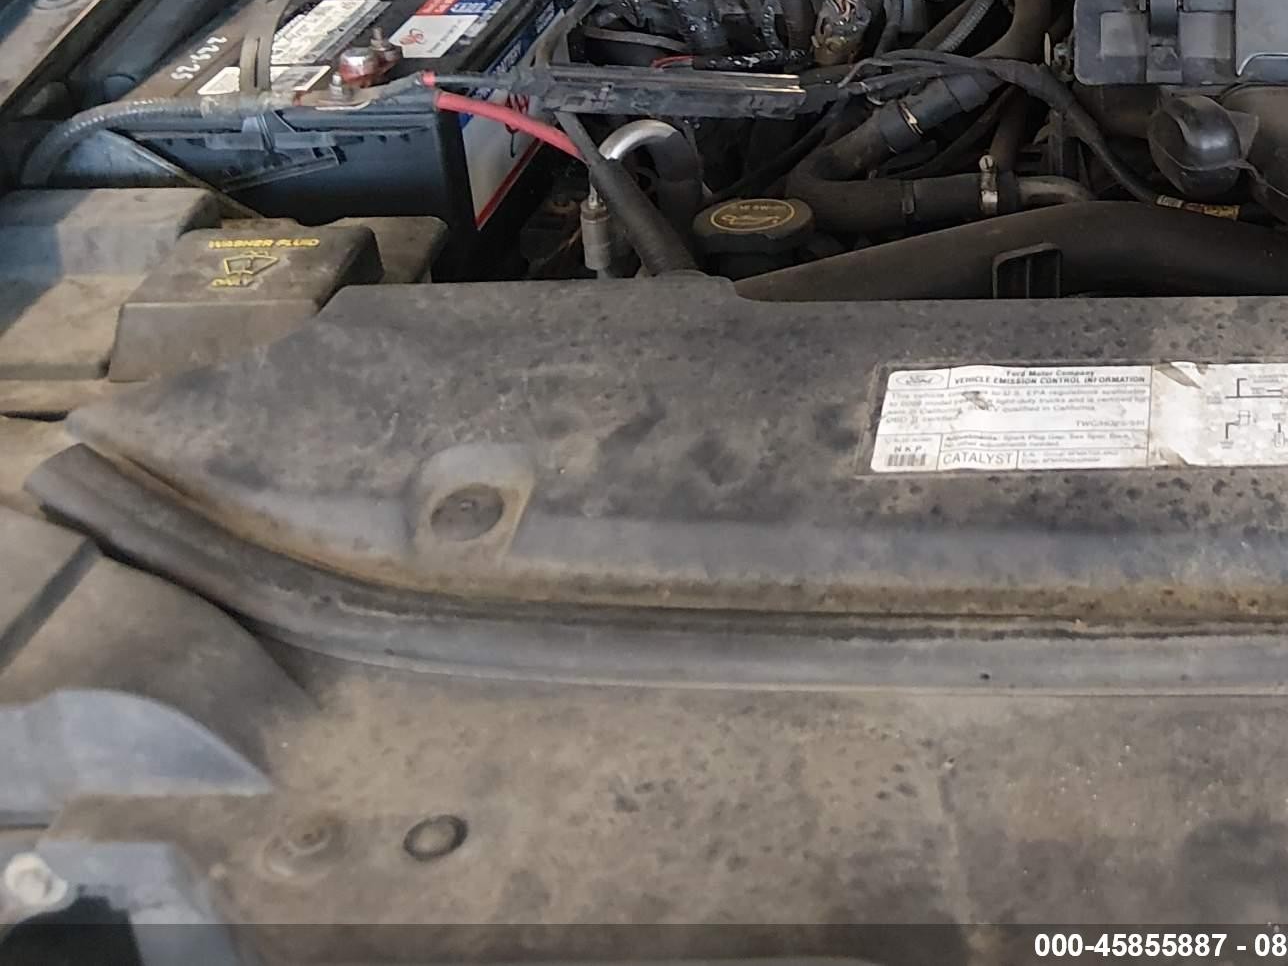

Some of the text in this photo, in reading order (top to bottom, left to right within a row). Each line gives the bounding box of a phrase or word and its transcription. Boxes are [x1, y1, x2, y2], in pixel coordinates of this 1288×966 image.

[208, 238, 320, 249] WASHER FLUID
[1055, 370, 1095, 378] Company
[1083, 376, 1145, 384] INFORMATION
[943, 452, 1013, 465] CATALYST
